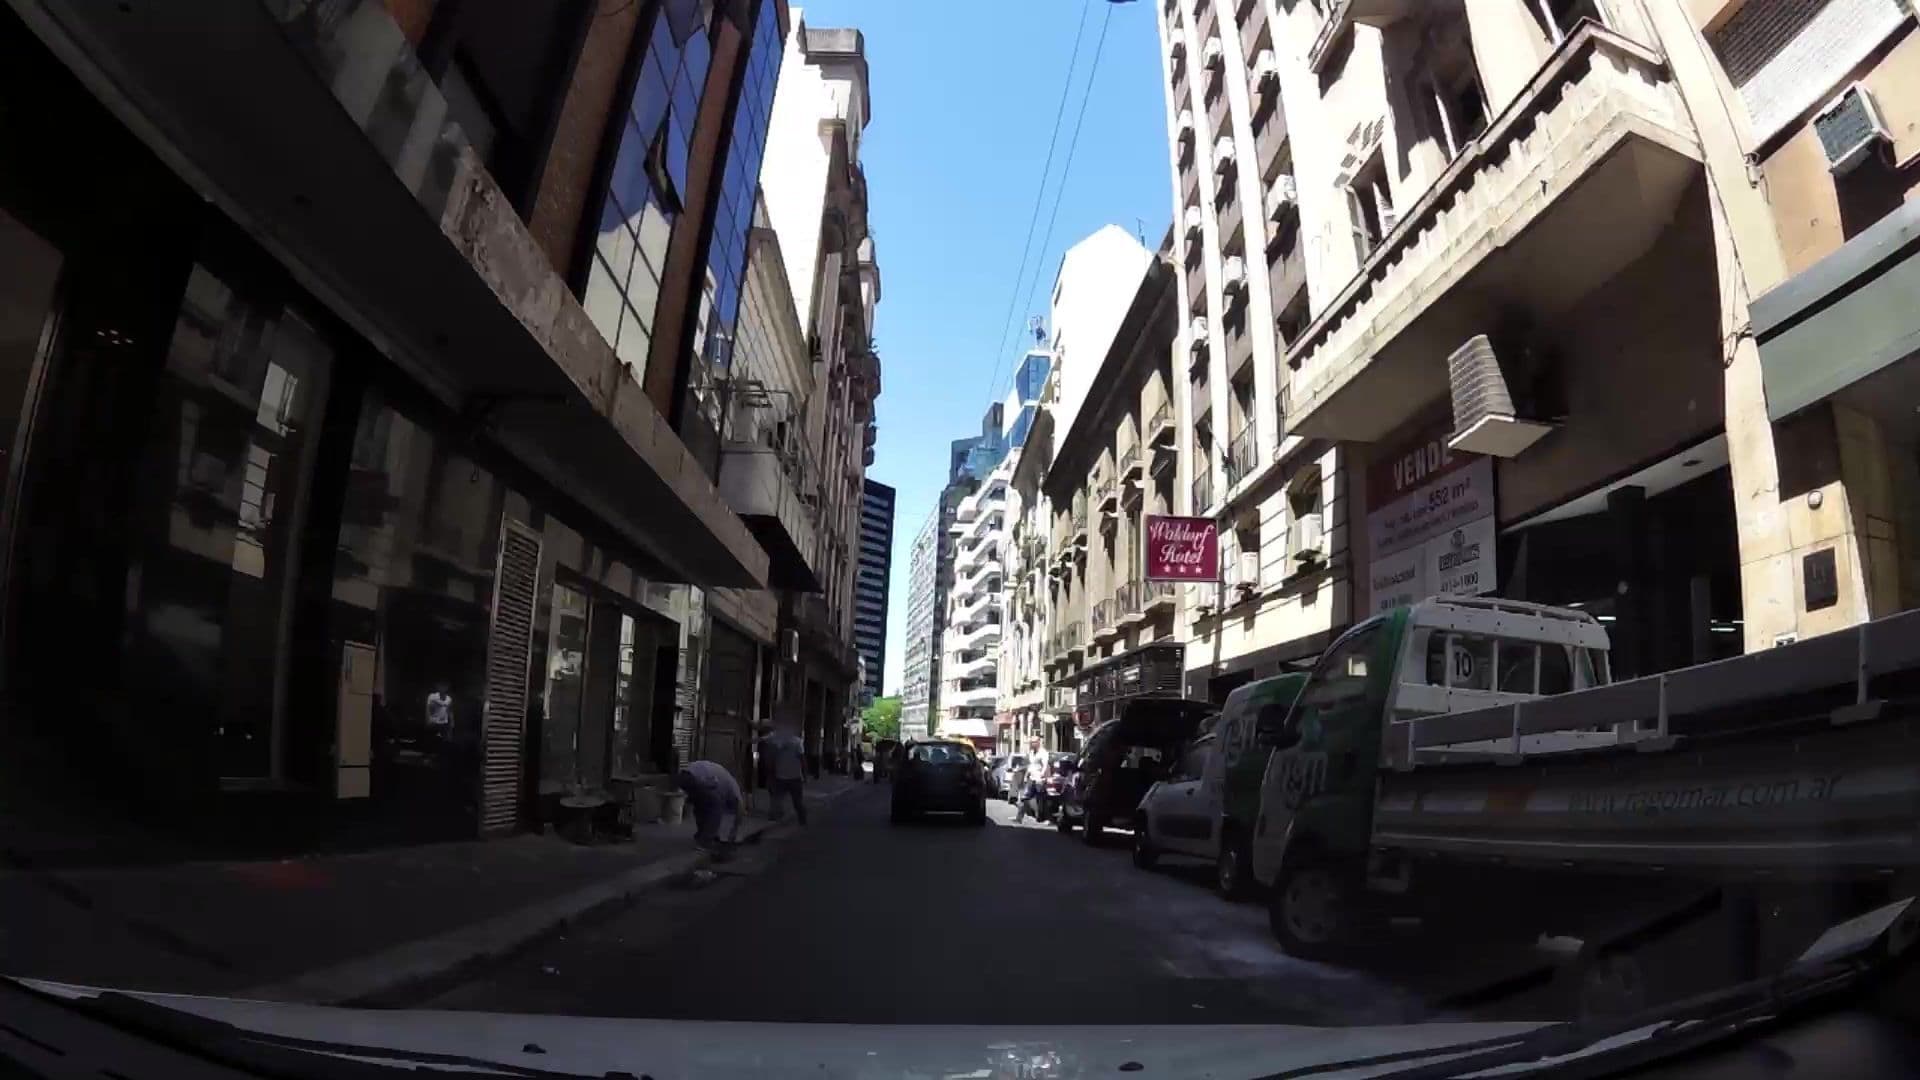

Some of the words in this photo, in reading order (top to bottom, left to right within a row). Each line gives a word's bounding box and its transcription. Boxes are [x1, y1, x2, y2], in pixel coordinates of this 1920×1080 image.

[1149, 521, 1215, 550] Waldorf
[1159, 543, 1204, 564] Hotel
[1454, 651, 1473, 678] 10
